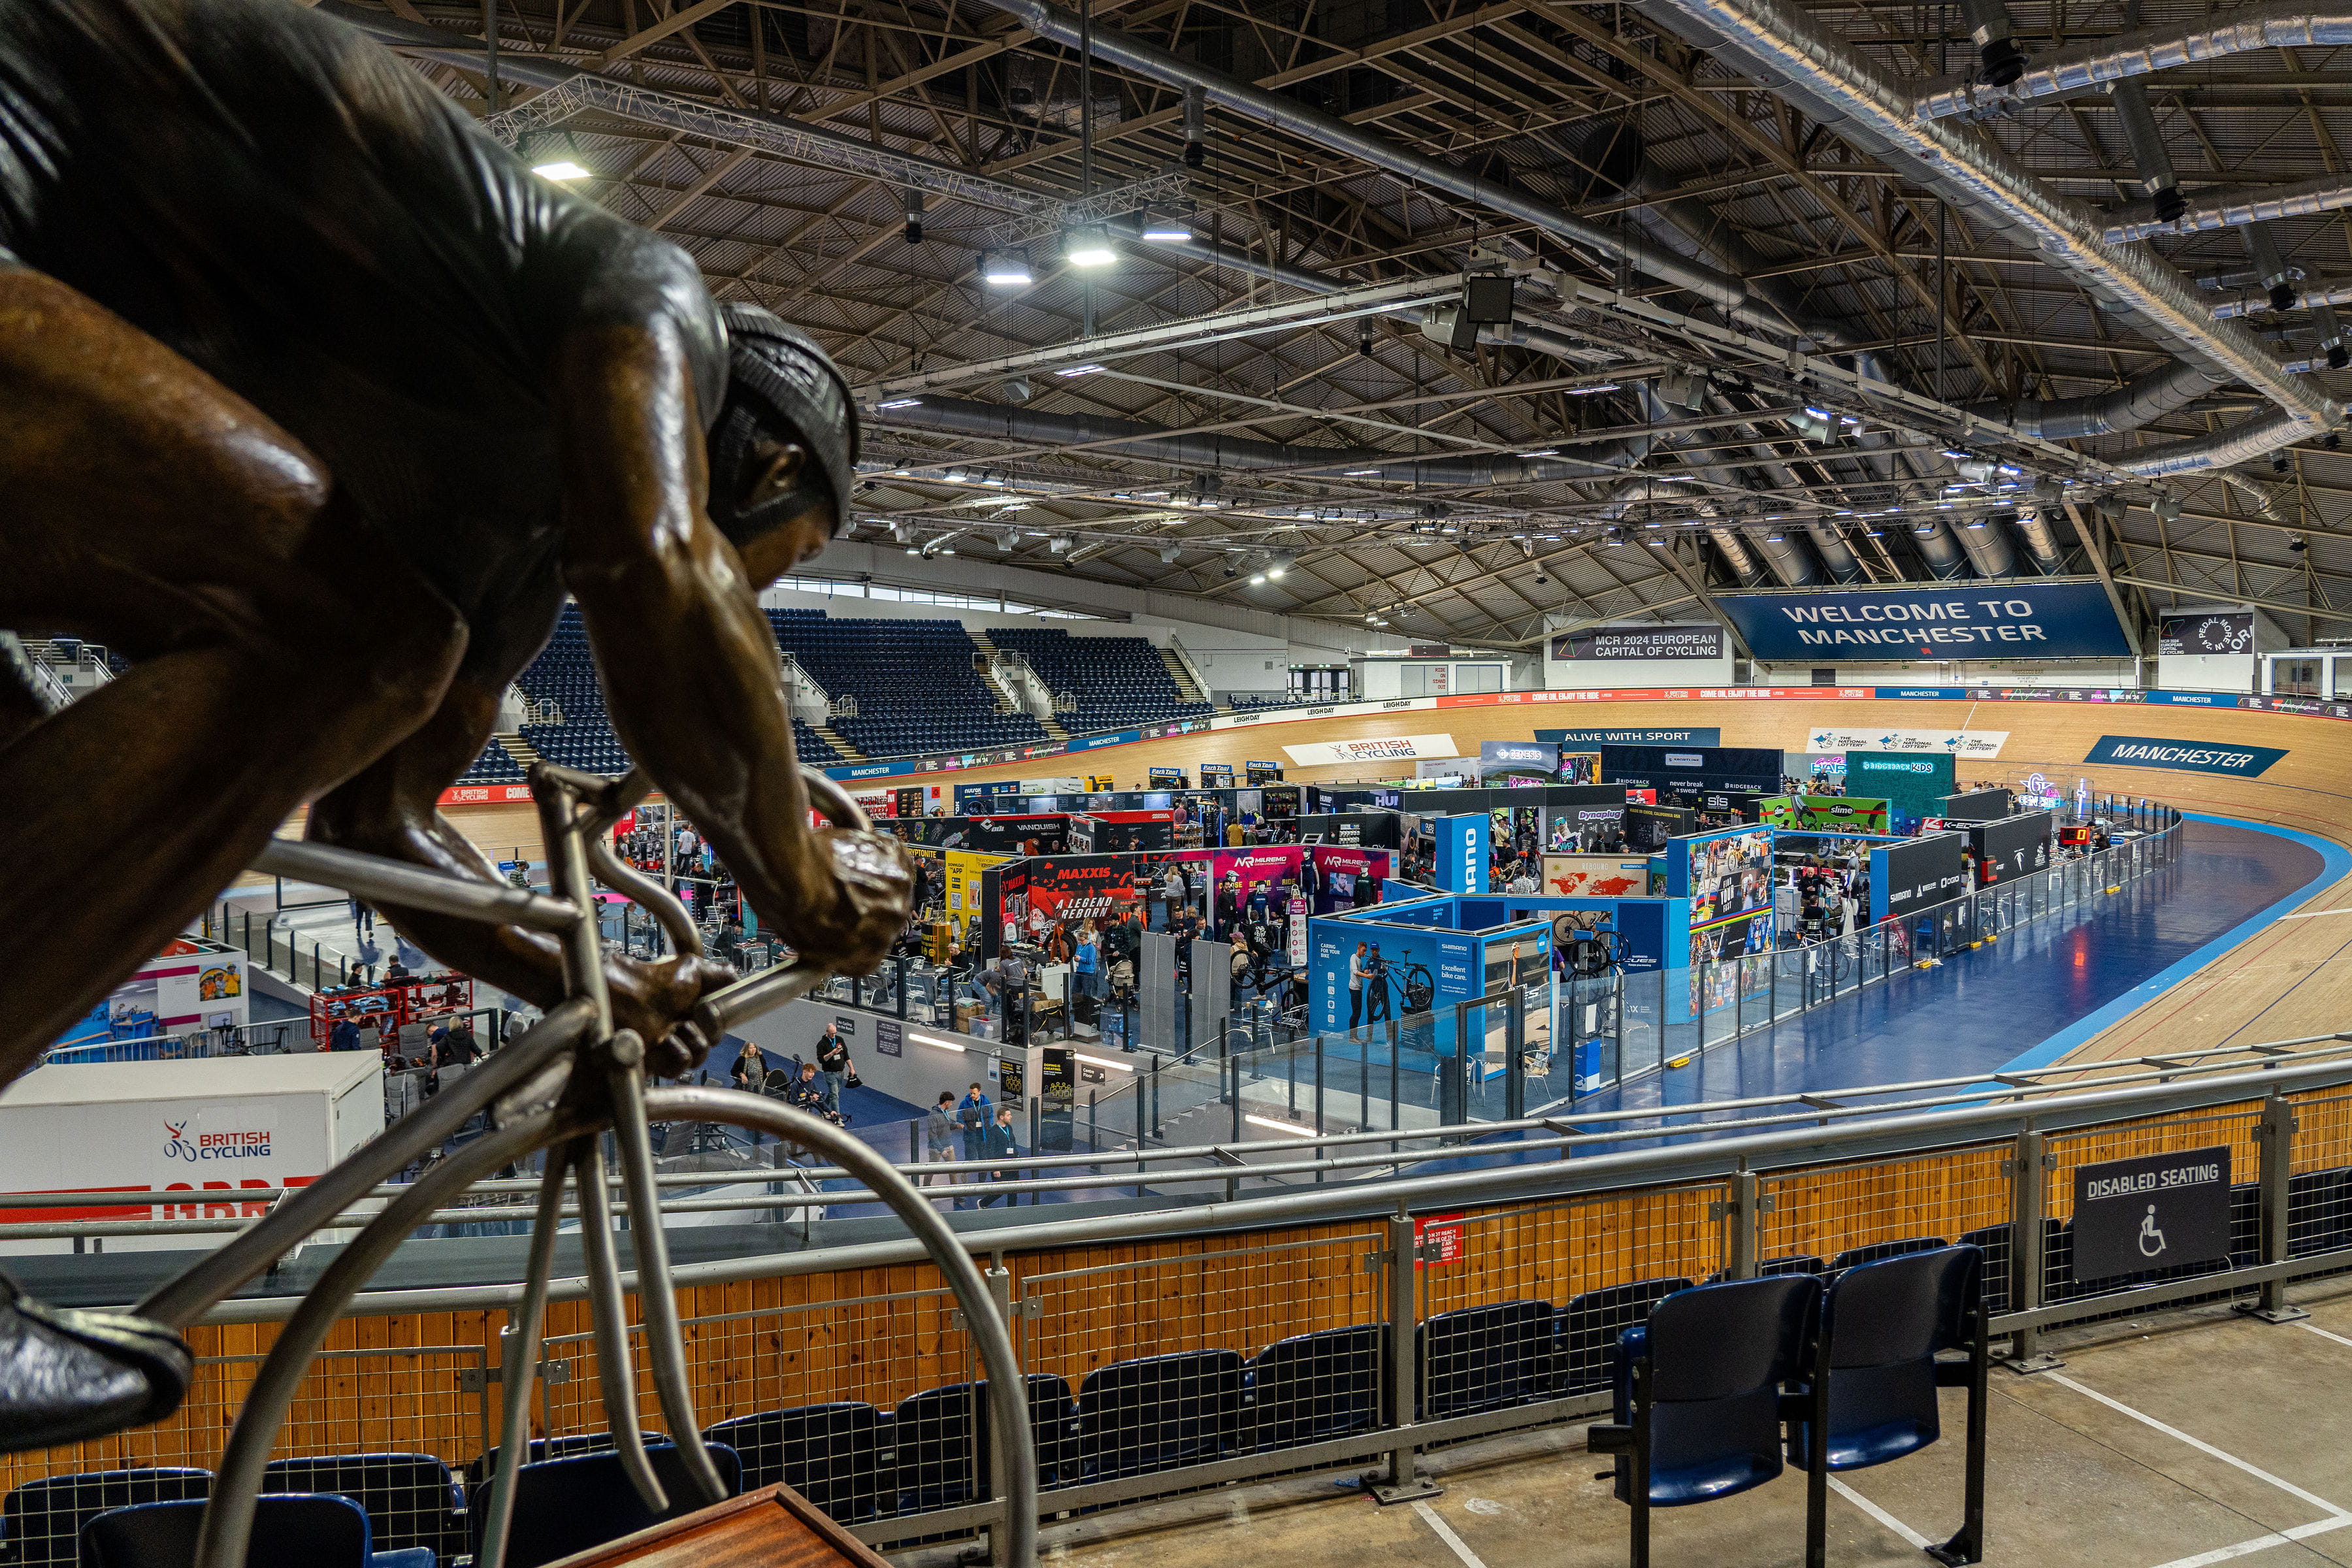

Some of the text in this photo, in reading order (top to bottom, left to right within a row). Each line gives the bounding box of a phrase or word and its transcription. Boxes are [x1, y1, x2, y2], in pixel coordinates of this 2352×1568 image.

[1782, 600, 2033, 623] WELCOME TO
[1595, 634, 1716, 645] MCR 2024 EUROPEAN
[1797, 625, 2048, 644] MANCHESTER
[1595, 645, 1717, 657] CAPITAL OF CYCLING
[1532, 693, 1548, 701] COME
[1088, 736, 1120, 747] MANCHESTER
[1565, 732, 1691, 742] ALIVE WITH SPORT
[1347, 740, 1413, 751] BRITISH
[1355, 748, 1417, 759] CYCLING
[1509, 750, 1541, 759] GENESIS
[2110, 744, 2255, 768] MANCHESTER
[851, 767, 890, 776] MANCHESTER
[1579, 809, 1622, 819] Dynaplug
[1830, 806, 1853, 815] slime
[908, 848, 936, 858] RYPTONITE
[1056, 867, 1111, 881] MAXXIS
[1720, 884, 1734, 905] YOUR
[1890, 889, 1912, 903] SHIMANO
[1055, 896, 1113, 909] A LEGEND
[1723, 901, 1732, 913] FAST
[1061, 907, 1108, 919] REBORN
[1441, 964, 1466, 973] Excellent
[199, 1131, 270, 1147] BRITISH
[200, 1145, 271, 1160] CYCLING
[2088, 1164, 2219, 1198] DISABLED SEATING
